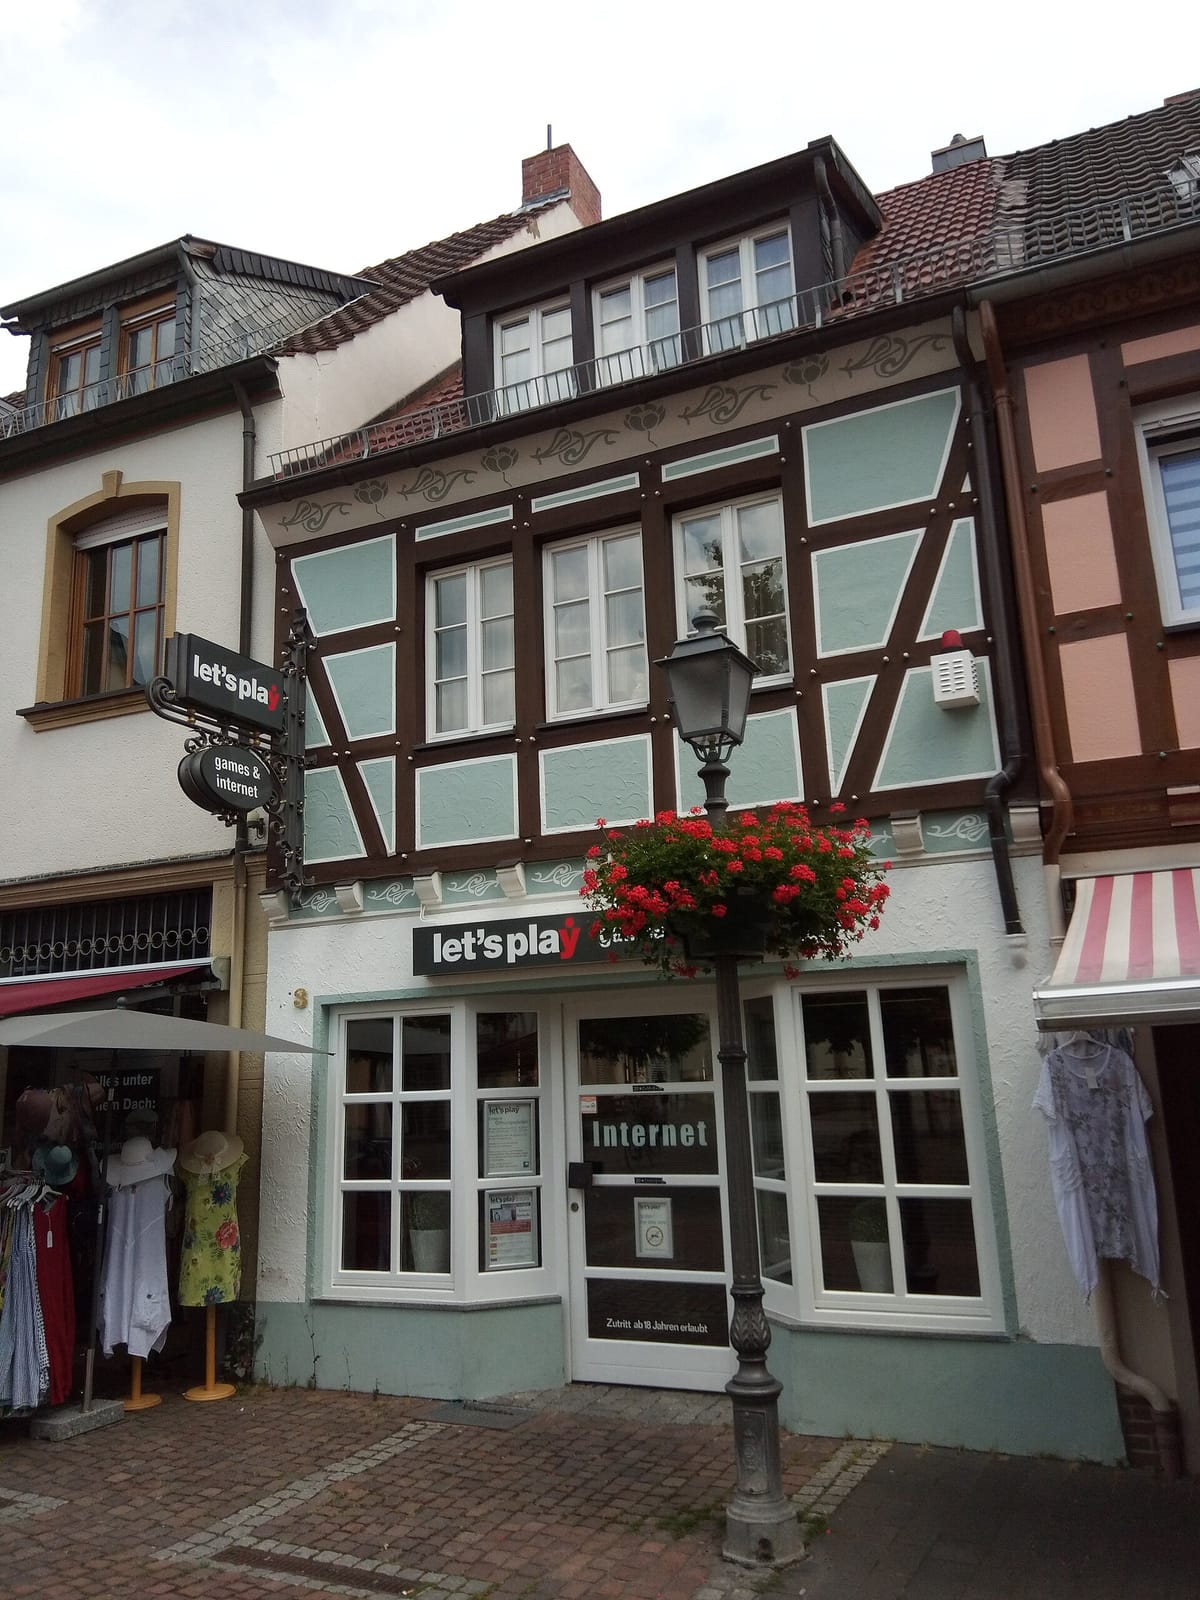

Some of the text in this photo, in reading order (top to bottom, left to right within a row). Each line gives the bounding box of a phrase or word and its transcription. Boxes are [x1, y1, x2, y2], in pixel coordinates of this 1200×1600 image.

[238, 677, 281, 712] play
[214, 756, 261, 780] games &
[216, 774, 258, 799] internet
[433, 928, 503, 964] let's
[507, 917, 581, 964] play
[122, 1073, 153, 1087] unter
[122, 1097, 156, 1111] Dach:
[592, 1120, 708, 1147] Internet
[606, 1317, 709, 1334] Zutritt ab 18 Jahren erlaubt
